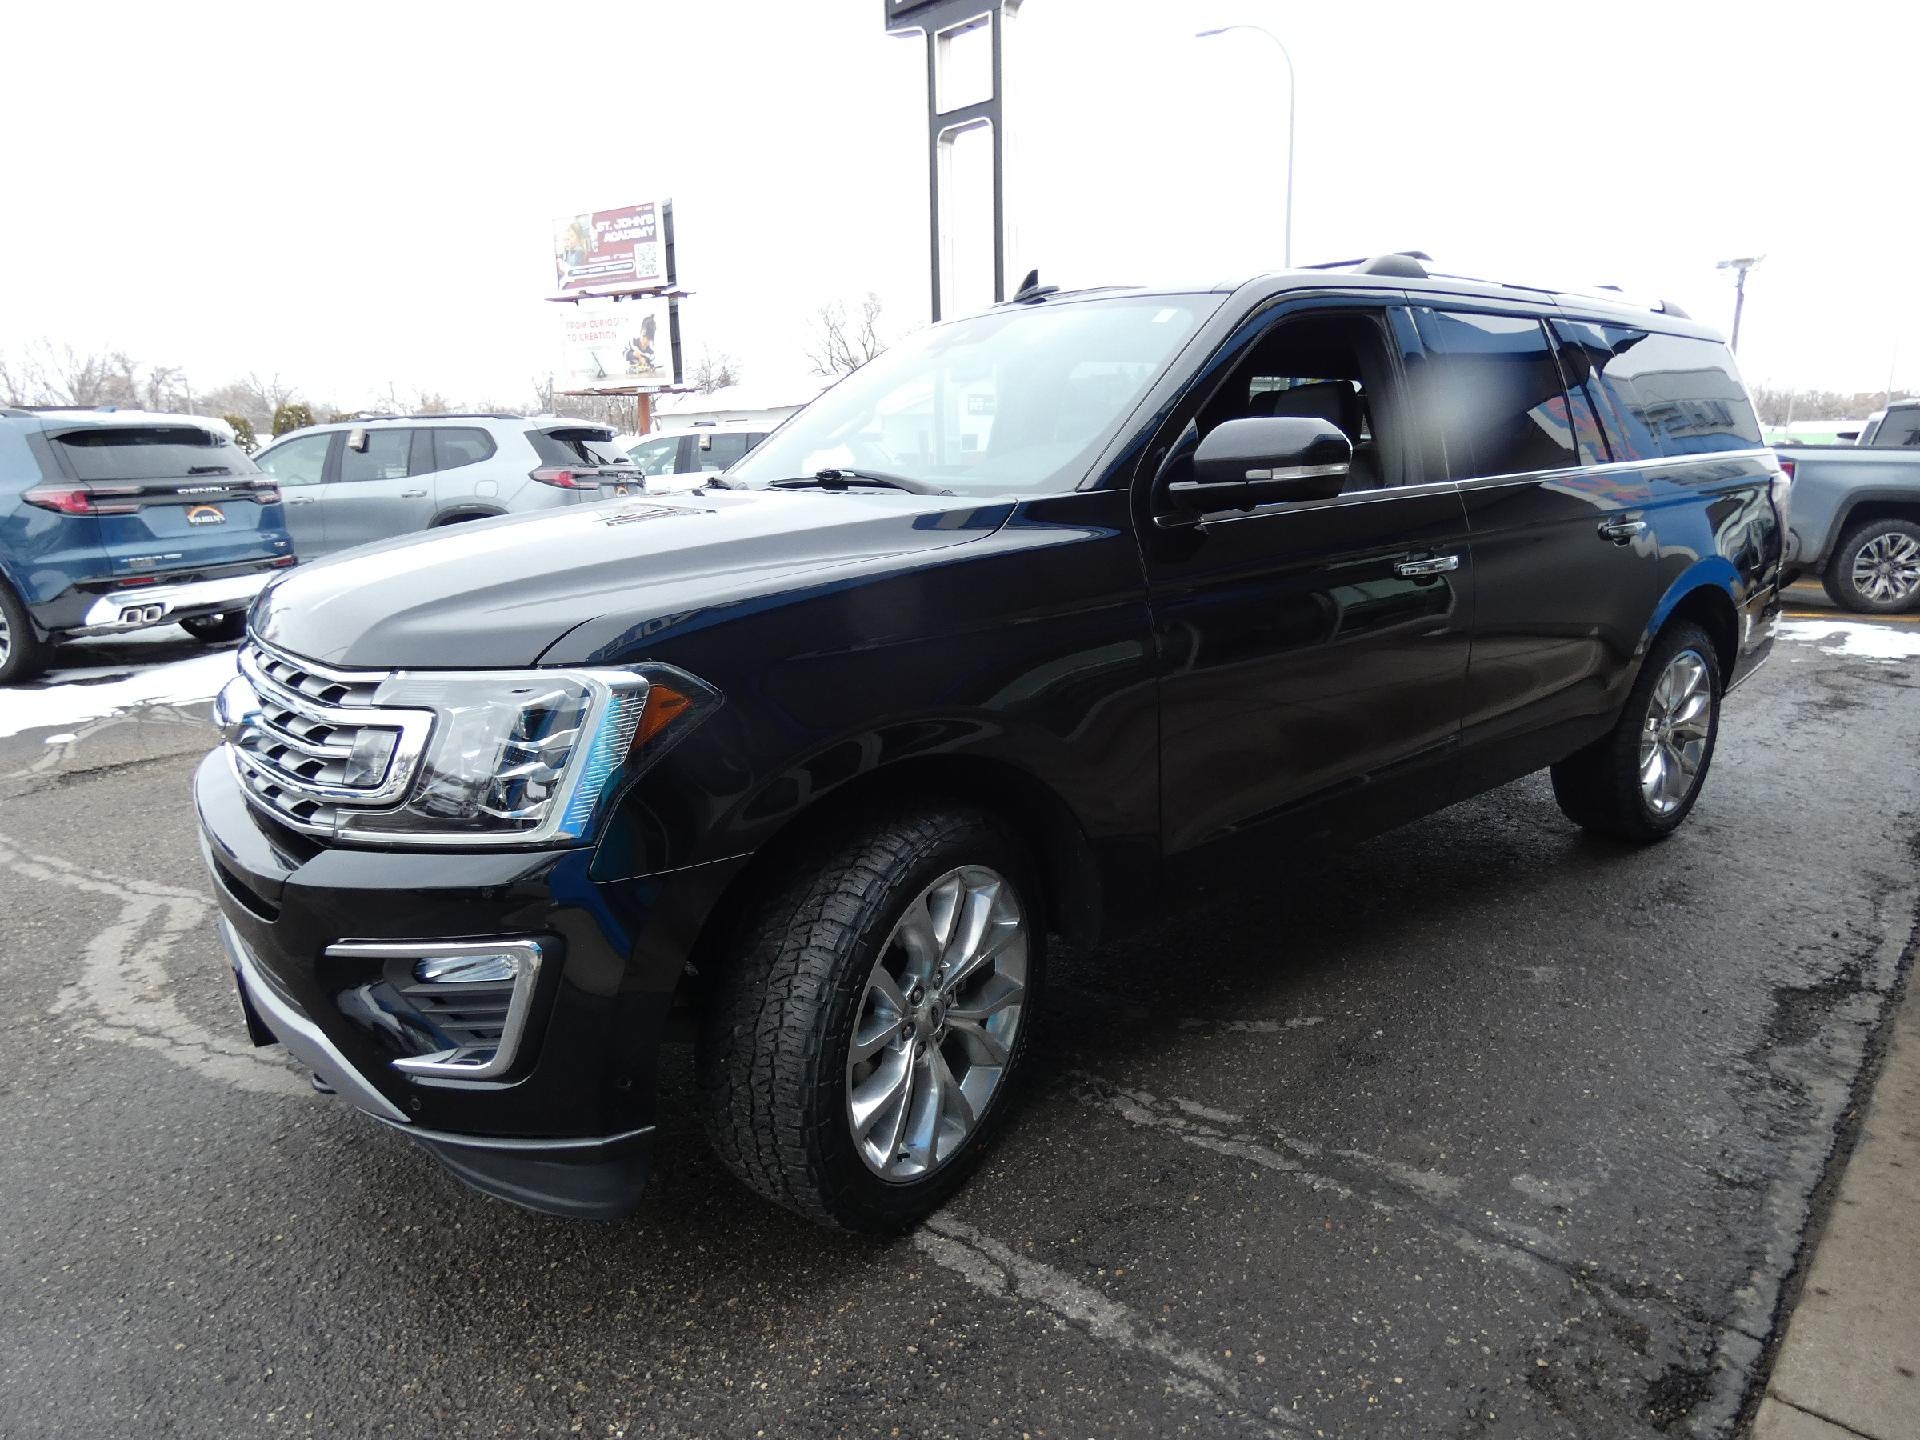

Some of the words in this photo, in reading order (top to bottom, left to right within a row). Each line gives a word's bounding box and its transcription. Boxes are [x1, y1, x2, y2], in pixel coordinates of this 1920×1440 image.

[596, 221, 612, 232] ST.
[603, 225, 655, 242] ACADEMY
[567, 332, 577, 342] TO
[177, 486, 230, 495] DENALI
